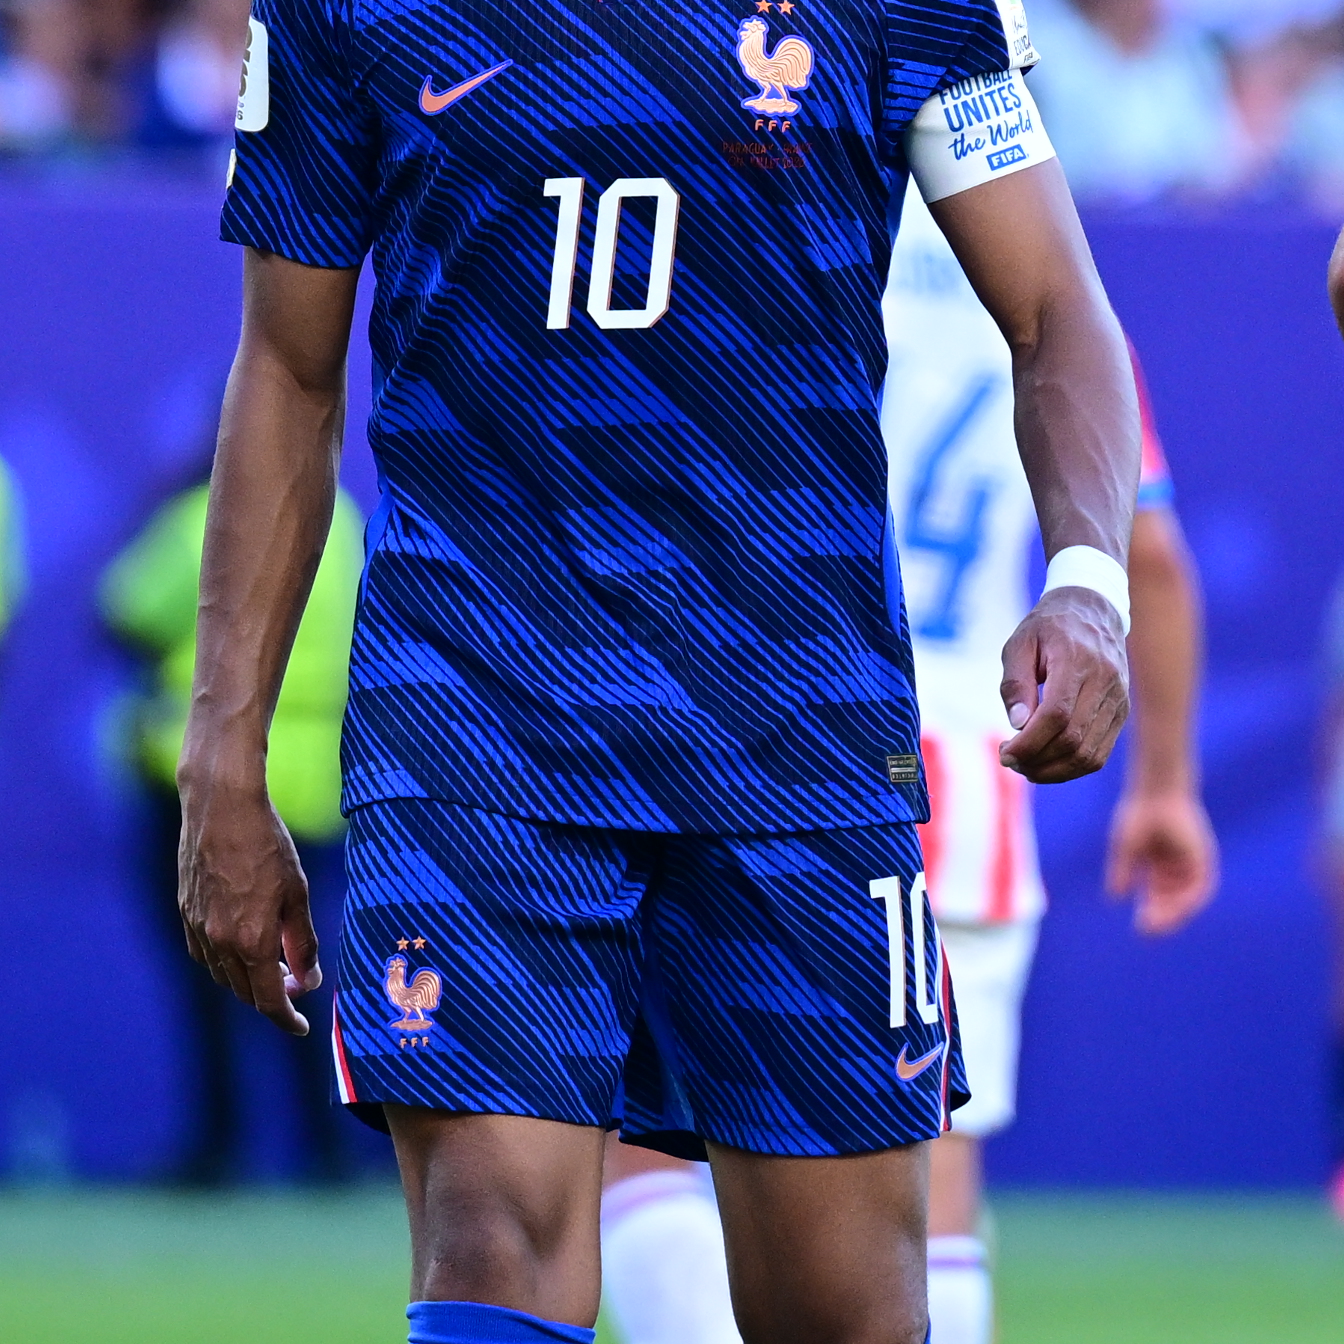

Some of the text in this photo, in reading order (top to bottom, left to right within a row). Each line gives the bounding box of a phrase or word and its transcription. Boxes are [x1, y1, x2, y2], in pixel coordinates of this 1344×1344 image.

[943, 82, 1022, 133] UNITES
[948, 109, 1034, 161] the World
[989, 145, 1025, 169] FIFA
[543, 177, 681, 329] 10
